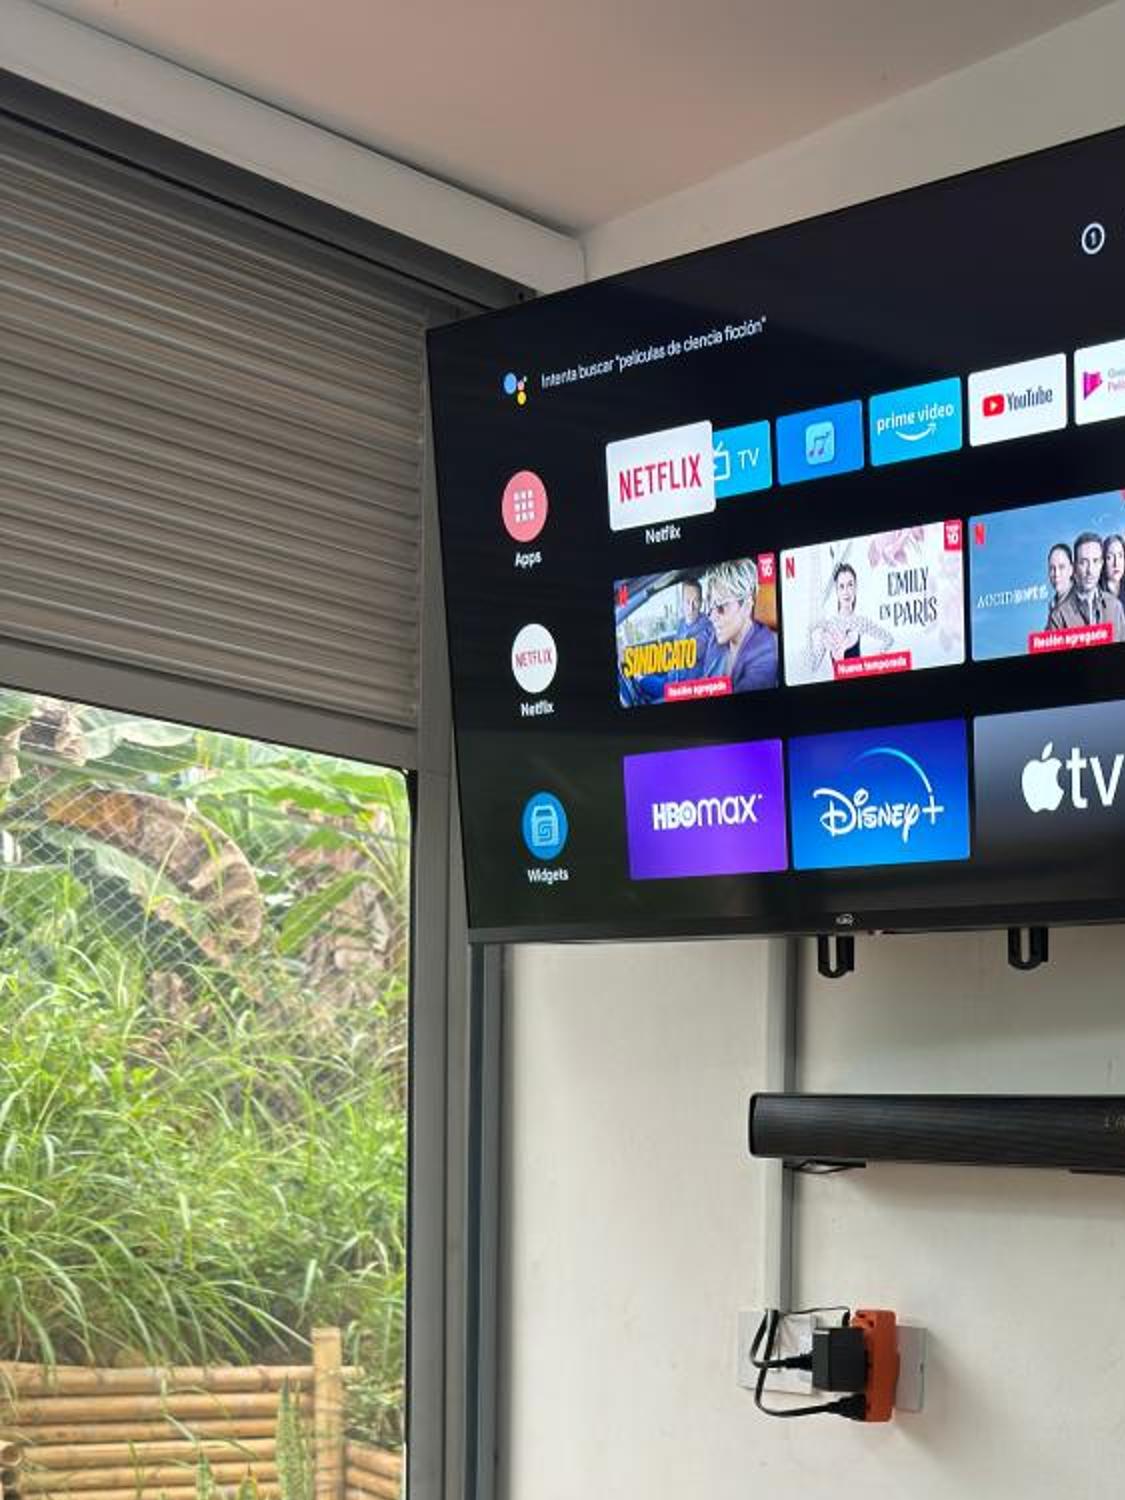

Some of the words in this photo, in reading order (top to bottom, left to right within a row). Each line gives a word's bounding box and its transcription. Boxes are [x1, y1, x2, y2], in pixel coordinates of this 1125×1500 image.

[541, 371, 577, 389] Intenta
[577, 359, 615, 379] buscar
[667, 340, 682, 356] de
[683, 330, 724, 350] ciencia
[1006, 386, 1053, 412] YouTube
[877, 412, 915, 436] prime
[917, 403, 955, 423] video
[737, 447, 760, 470] TV
[619, 453, 702, 504] NETFLIX
[645, 524, 681, 544] Netflix
[514, 552, 542, 569] Apps
[785, 557, 795, 579] N
[887, 566, 929, 597] EMILY
[515, 649, 552, 669] NETFLIX
[623, 638, 697, 677] SINDICATO
[521, 702, 555, 717] Netflix
[1066, 747, 1125, 809] tv
[527, 867, 569, 884] Widgets
